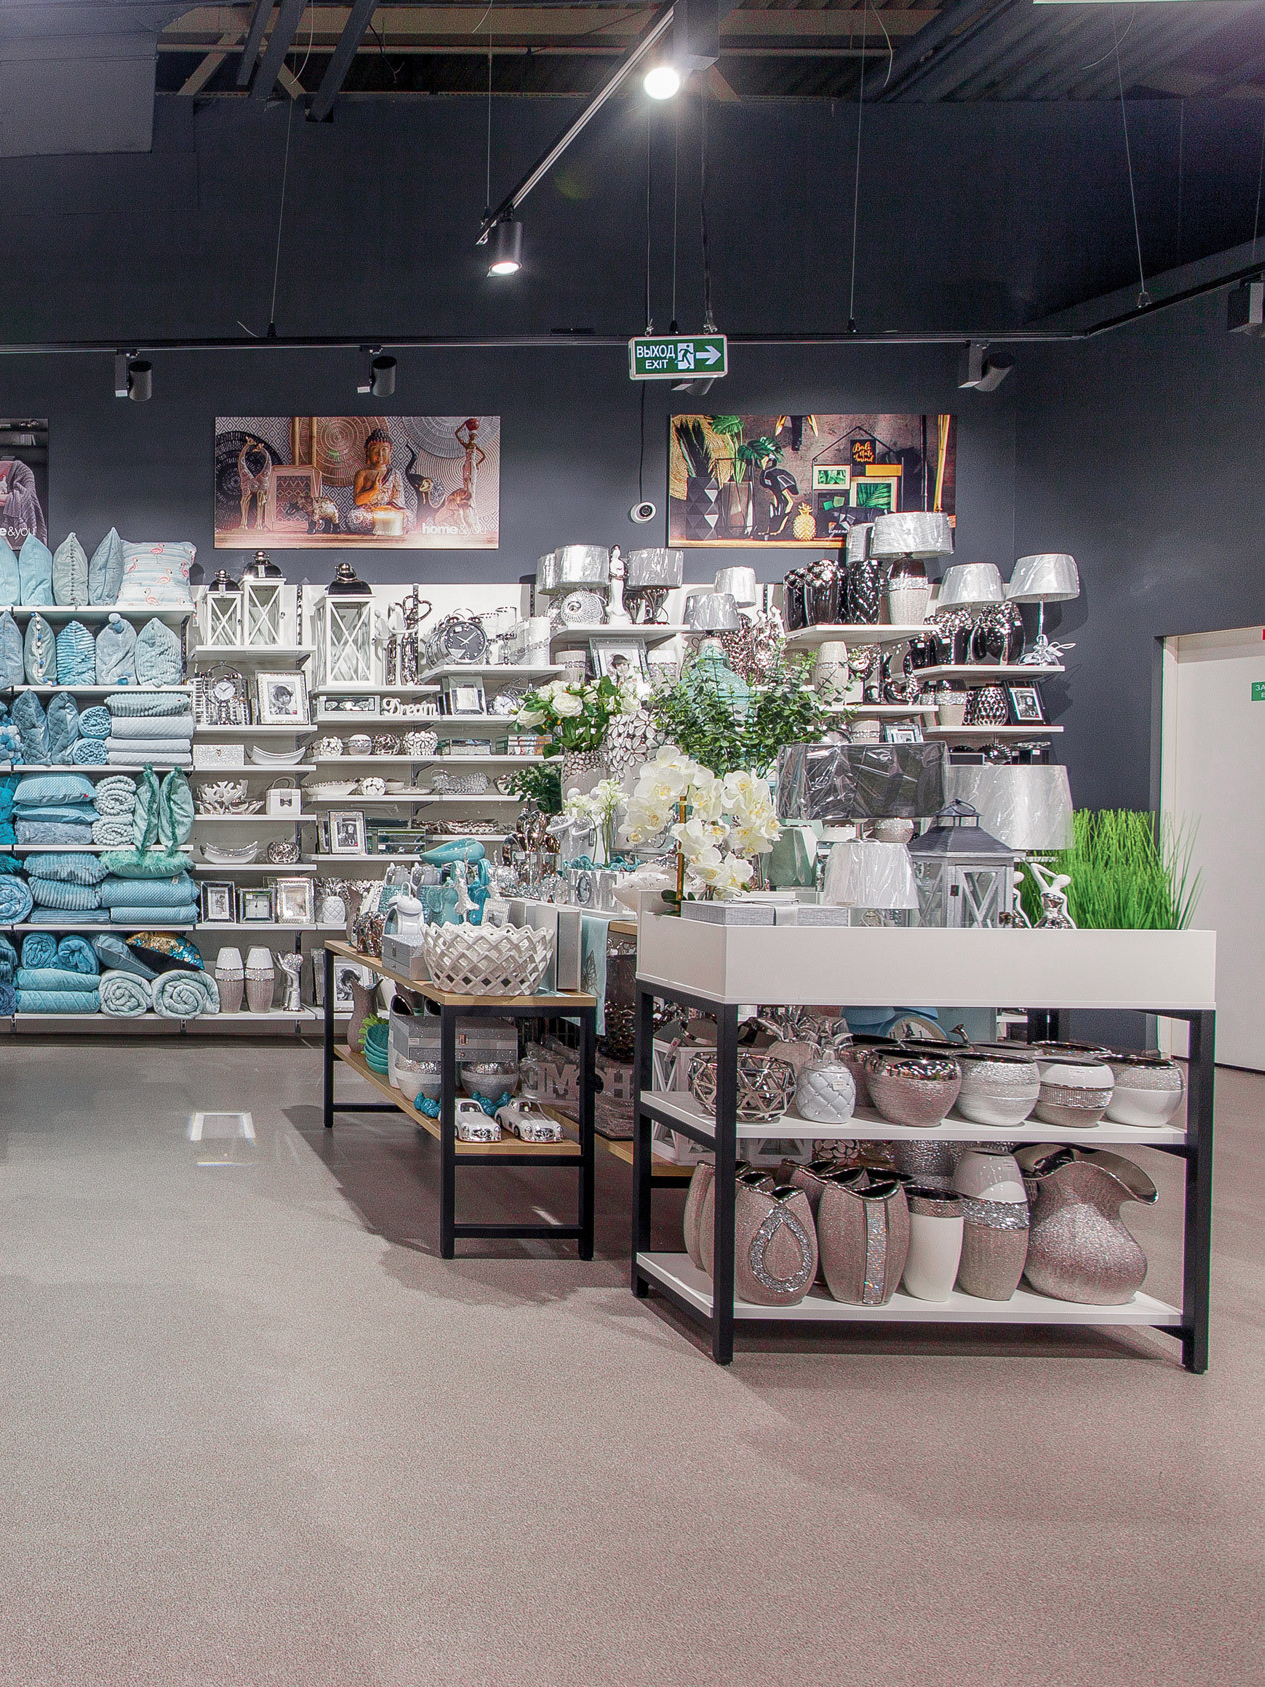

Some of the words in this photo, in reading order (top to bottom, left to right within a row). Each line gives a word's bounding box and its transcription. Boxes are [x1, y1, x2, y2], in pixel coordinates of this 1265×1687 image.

[636, 344, 675, 359] ВЫХОД
[645, 359, 668, 369] EXIT
[422, 522, 486, 537] home&you
[382, 697, 439, 717] Dream
